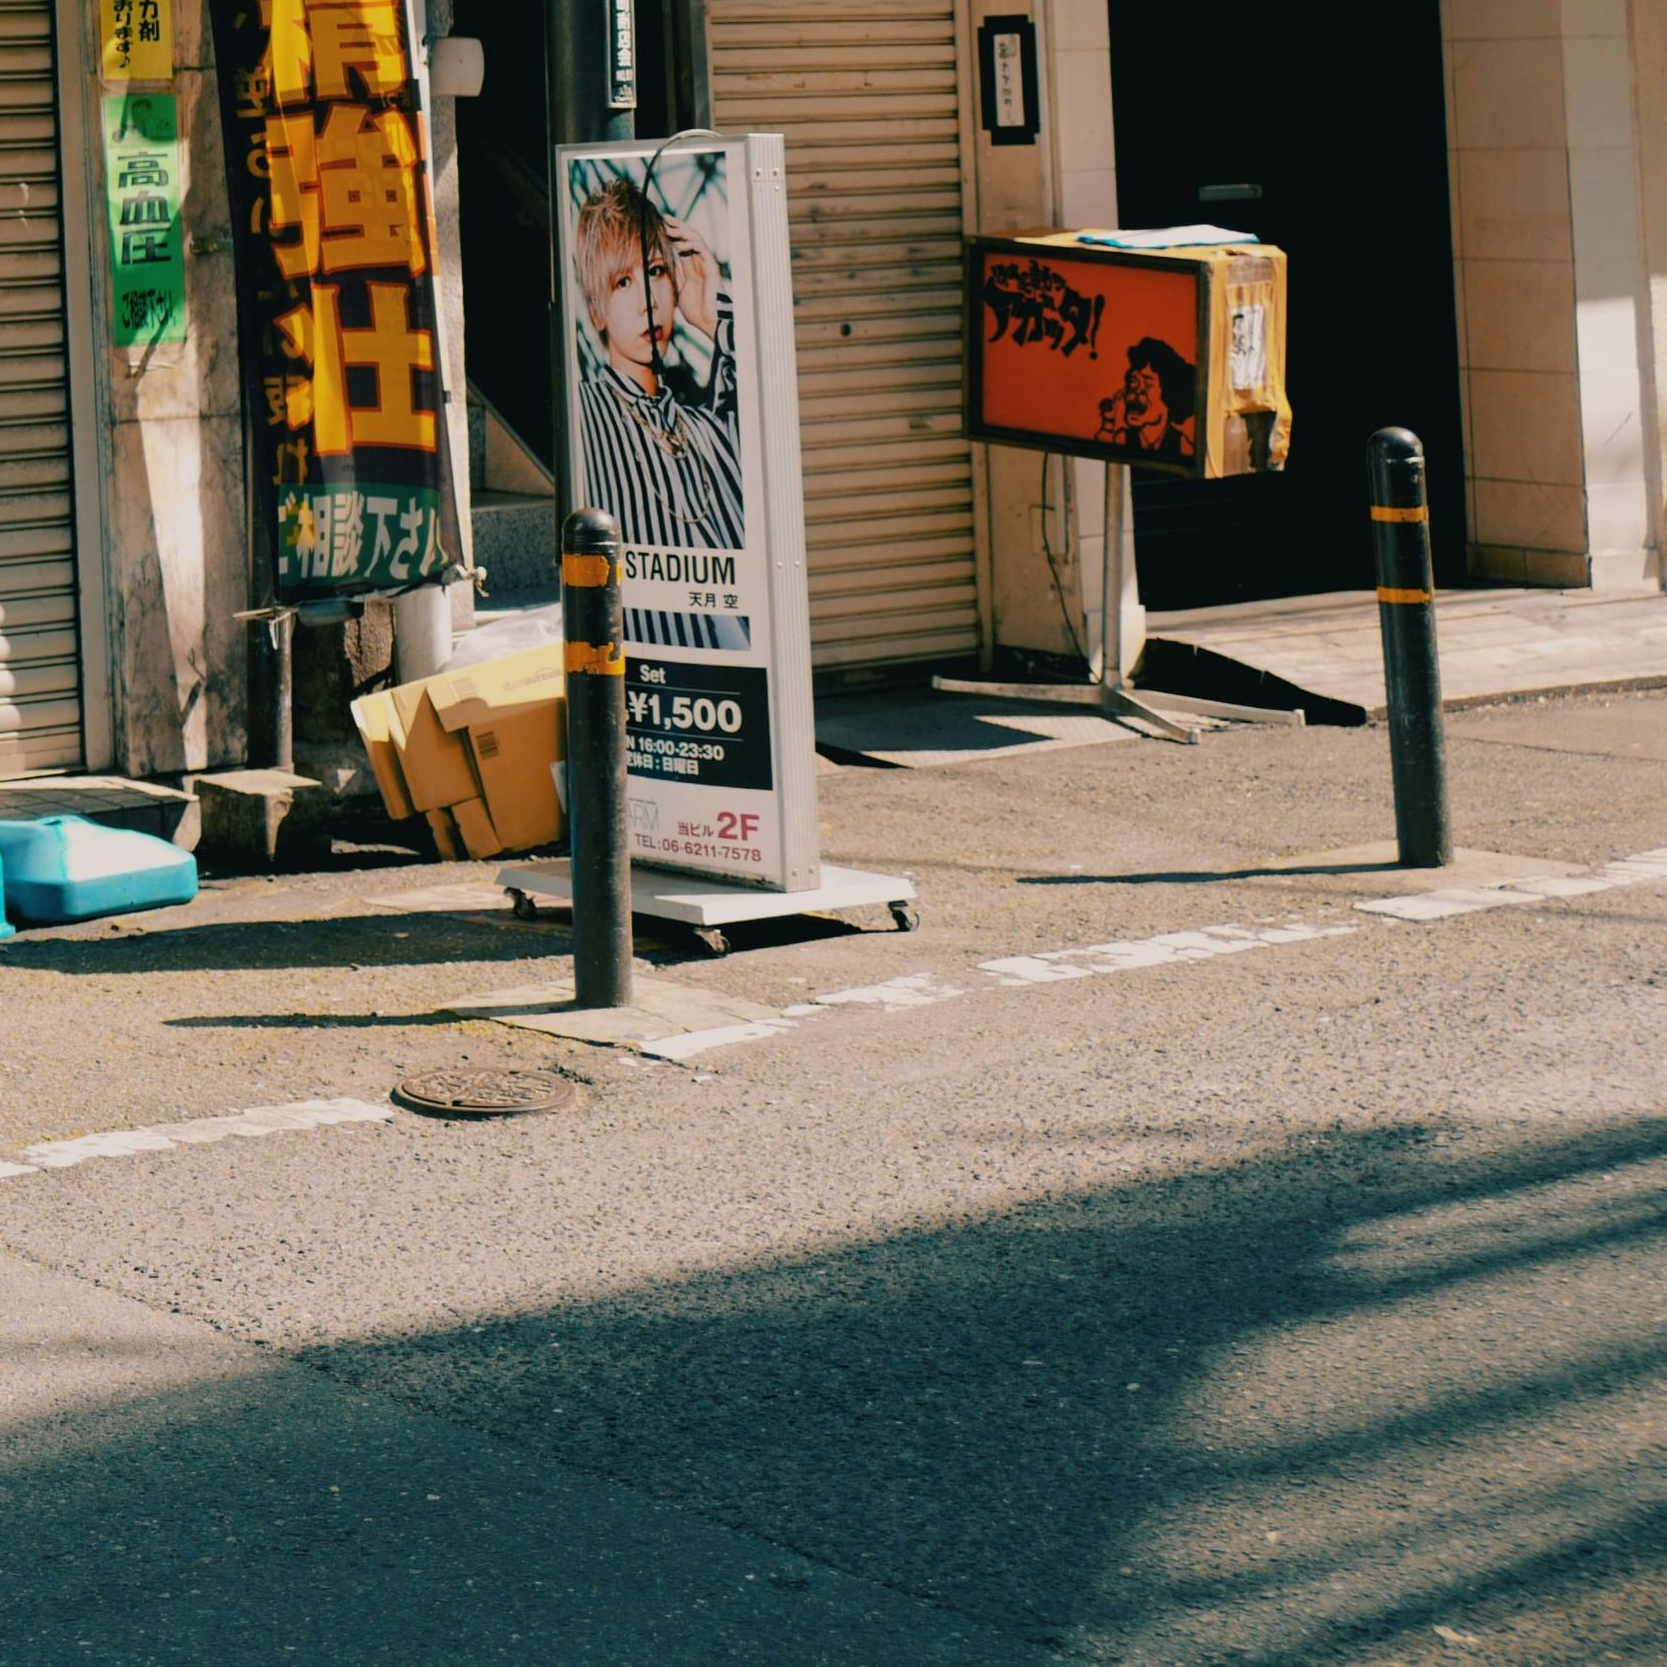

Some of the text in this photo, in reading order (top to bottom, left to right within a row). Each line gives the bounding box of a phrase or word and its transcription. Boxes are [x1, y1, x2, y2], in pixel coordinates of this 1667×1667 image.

[116, 149, 173, 266] 高血圧
[625, 550, 736, 585] STADIUM
[689, 591, 738, 609] 天月 空
[640, 664, 666, 684] Set
[628, 691, 743, 733] ¥1,500
[638, 737, 725, 761] 16:00-23:30
[678, 811, 760, 841] 当ビル 2F
[635, 833, 762, 863] TEL:06-6211-7578
